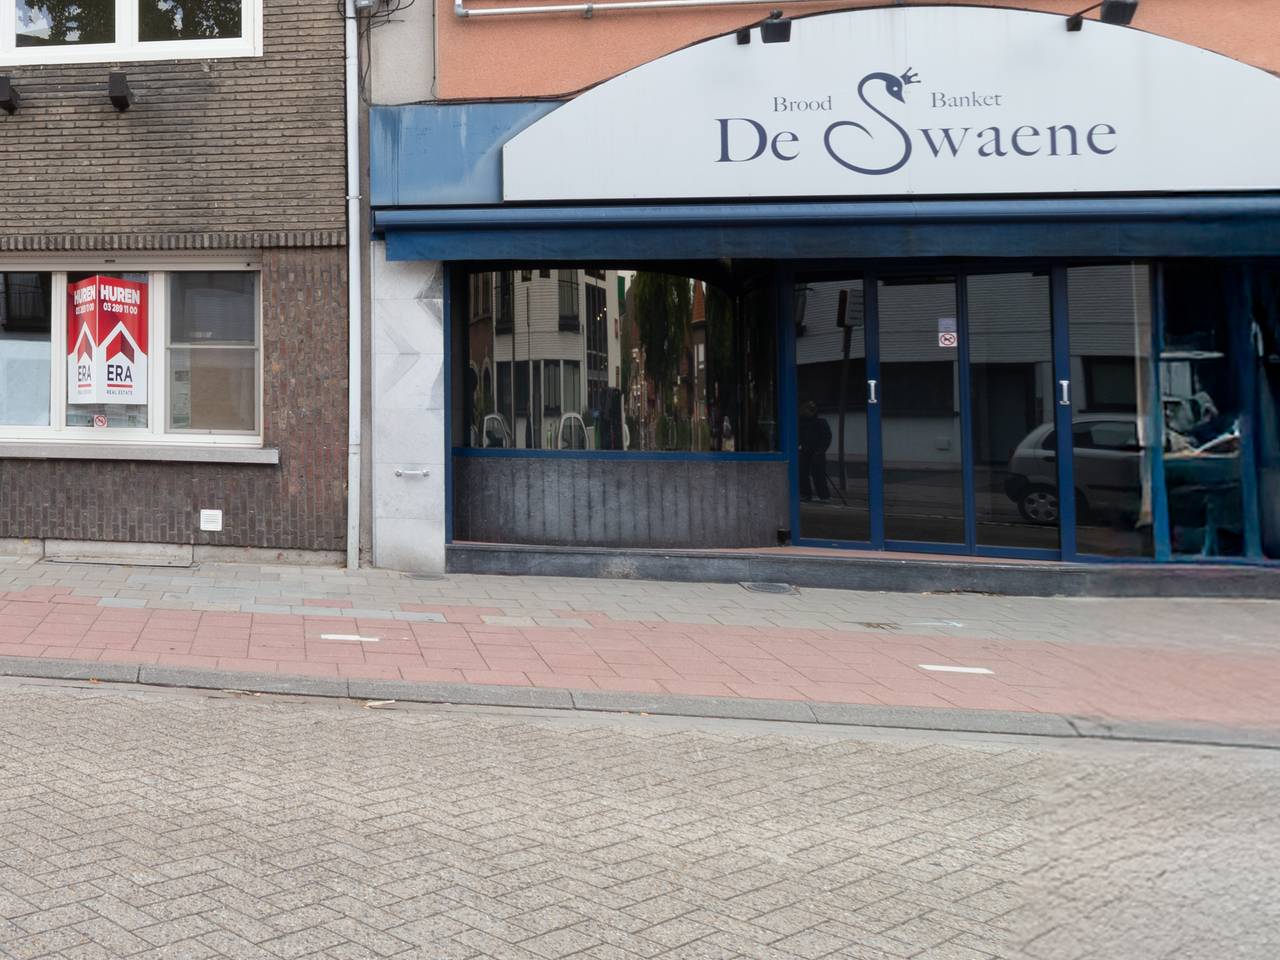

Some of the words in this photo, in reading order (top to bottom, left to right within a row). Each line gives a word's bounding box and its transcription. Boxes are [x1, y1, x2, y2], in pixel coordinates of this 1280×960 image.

[773, 95, 833, 113] Brood
[930, 91, 1002, 108] Banket
[713, 117, 800, 163] De
[823, 70, 1118, 176] Swaene
[74, 284, 96, 305] HUREN
[100, 284, 140, 305] HUREN
[103, 302, 112, 312] 03
[124, 305, 129, 314] 11
[129, 306, 138, 315] 00
[77, 365, 92, 382] ERA
[107, 364, 133, 382] ERA
